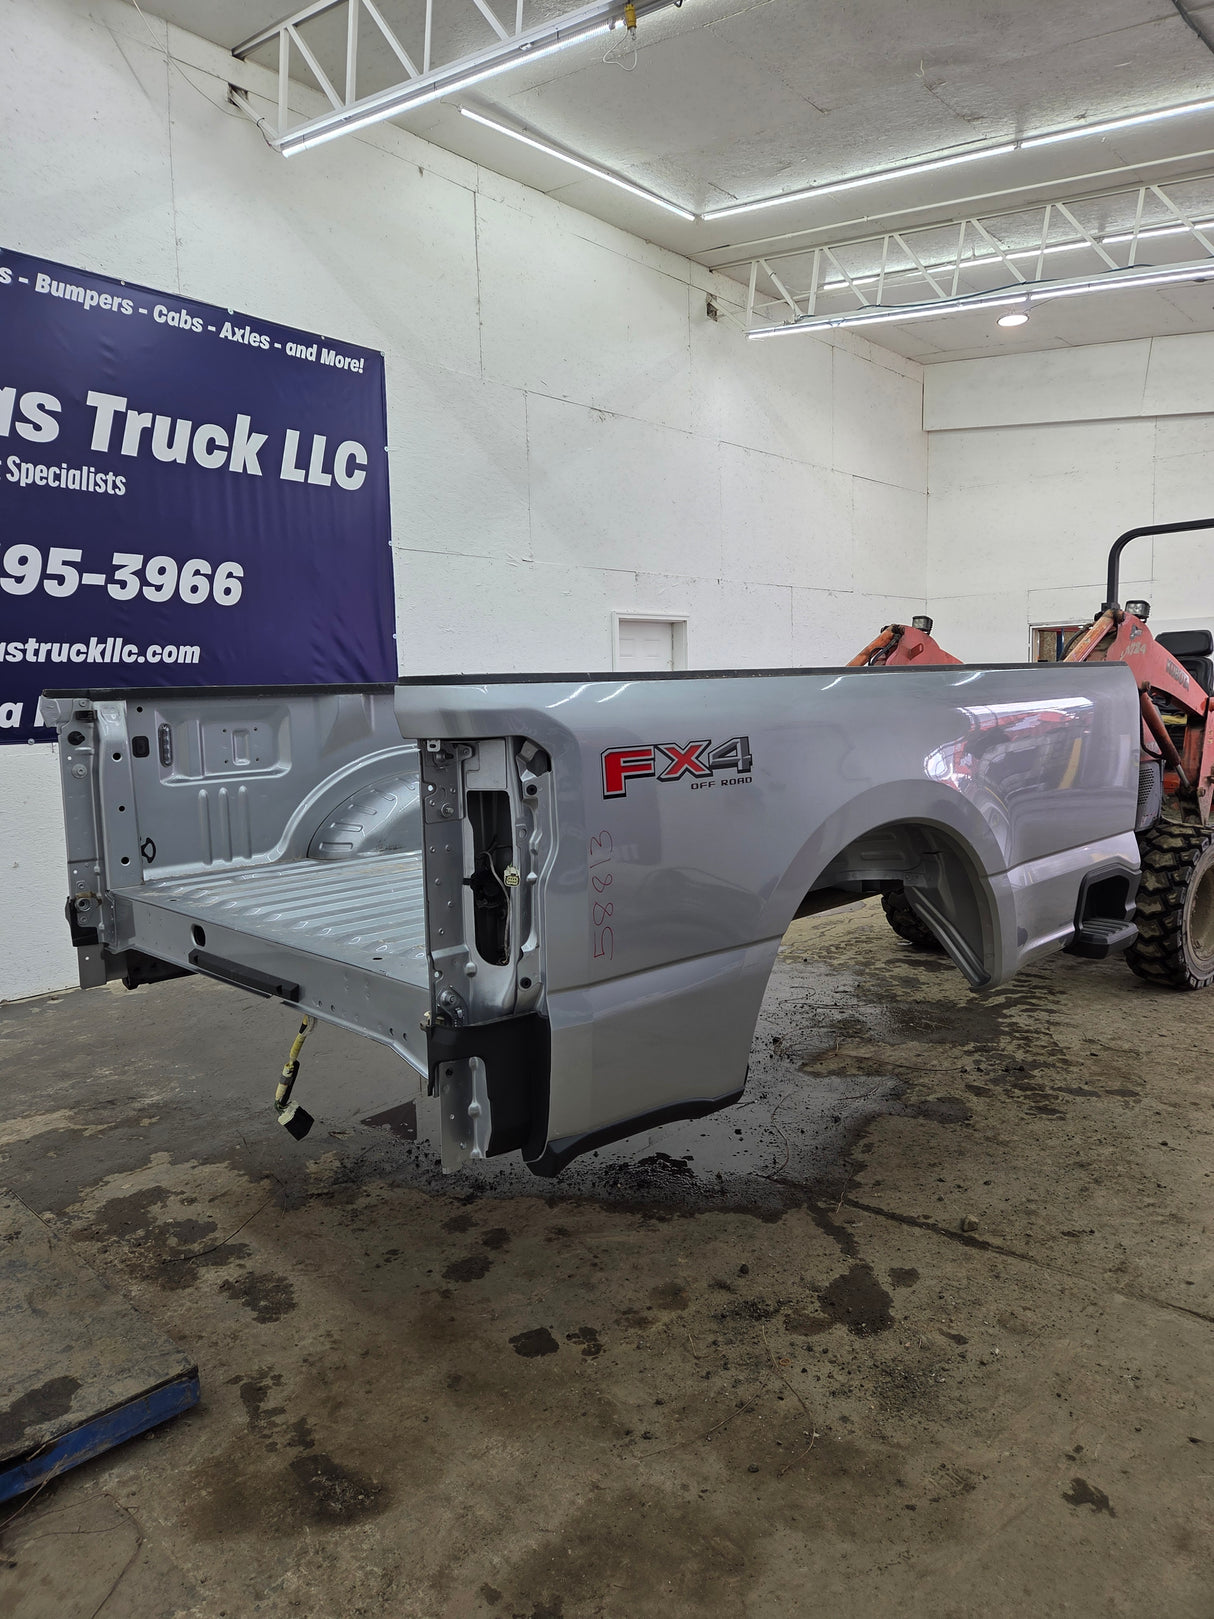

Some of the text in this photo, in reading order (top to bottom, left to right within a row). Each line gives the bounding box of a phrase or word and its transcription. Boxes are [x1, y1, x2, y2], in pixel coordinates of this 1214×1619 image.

[34, 272, 134, 316] Bumpers
[153, 304, 204, 333] Cabs
[218, 321, 271, 350] Axles
[285, 341, 318, 362] and
[319, 347, 366, 374] More!
[86, 390, 269, 477] Truck
[279, 428, 368, 491] LLC
[5, 455, 127, 496] Specialists
[0, 543, 244, 606] 95-3966
[0, 637, 201, 664] struckllc.com
[600, 735, 753, 800] FX4
[690, 776, 753, 790] OFF ROAD
[589, 829, 615, 961] 58813
